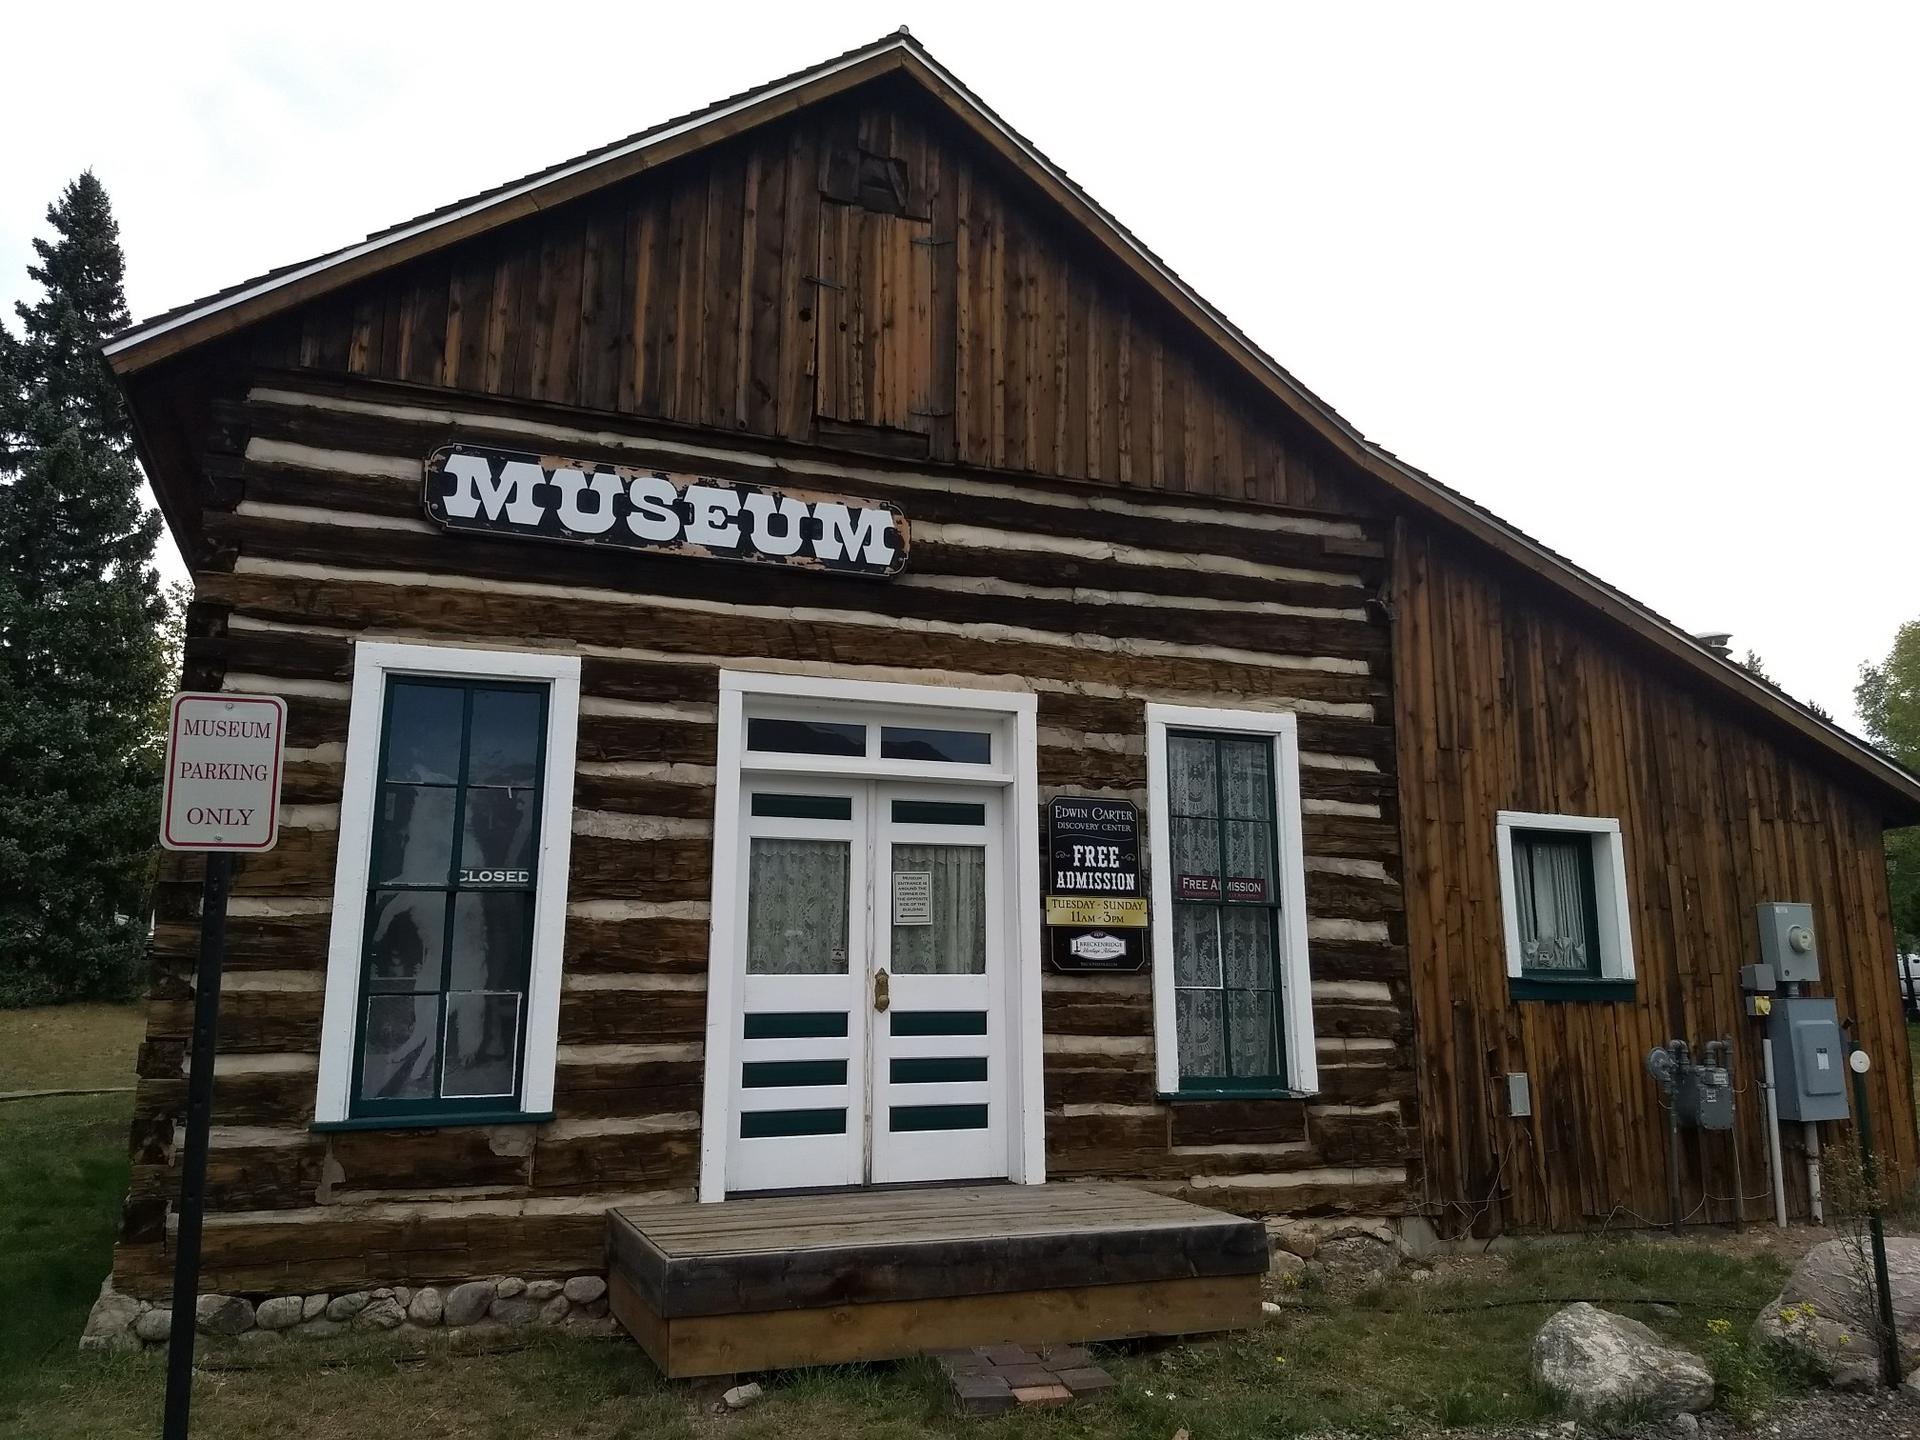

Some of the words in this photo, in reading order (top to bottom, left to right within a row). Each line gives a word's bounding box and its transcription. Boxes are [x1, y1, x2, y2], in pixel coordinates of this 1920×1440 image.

[442, 453, 896, 566] MUSEUM
[183, 718, 272, 739] MUSEUM
[179, 761, 269, 782] PARKING
[186, 807, 256, 826] ONLY
[1055, 805, 1088, 819] EDWIN
[1091, 807, 1135, 823] CARTER
[1057, 821, 1100, 831] DISCOVERY
[1101, 823, 1132, 832] CENTER
[1072, 844, 1120, 869] FREE
[459, 869, 530, 882] CLOSED
[1056, 870, 1135, 890] ADMISSION
[1182, 877, 1208, 890] FREE
[1052, 898, 1096, 909] TUESDAY
[1103, 900, 1144, 911] SUNDAY
[1071, 911, 1096, 922] 11AM
[1103, 911, 1124, 923] 3PM
